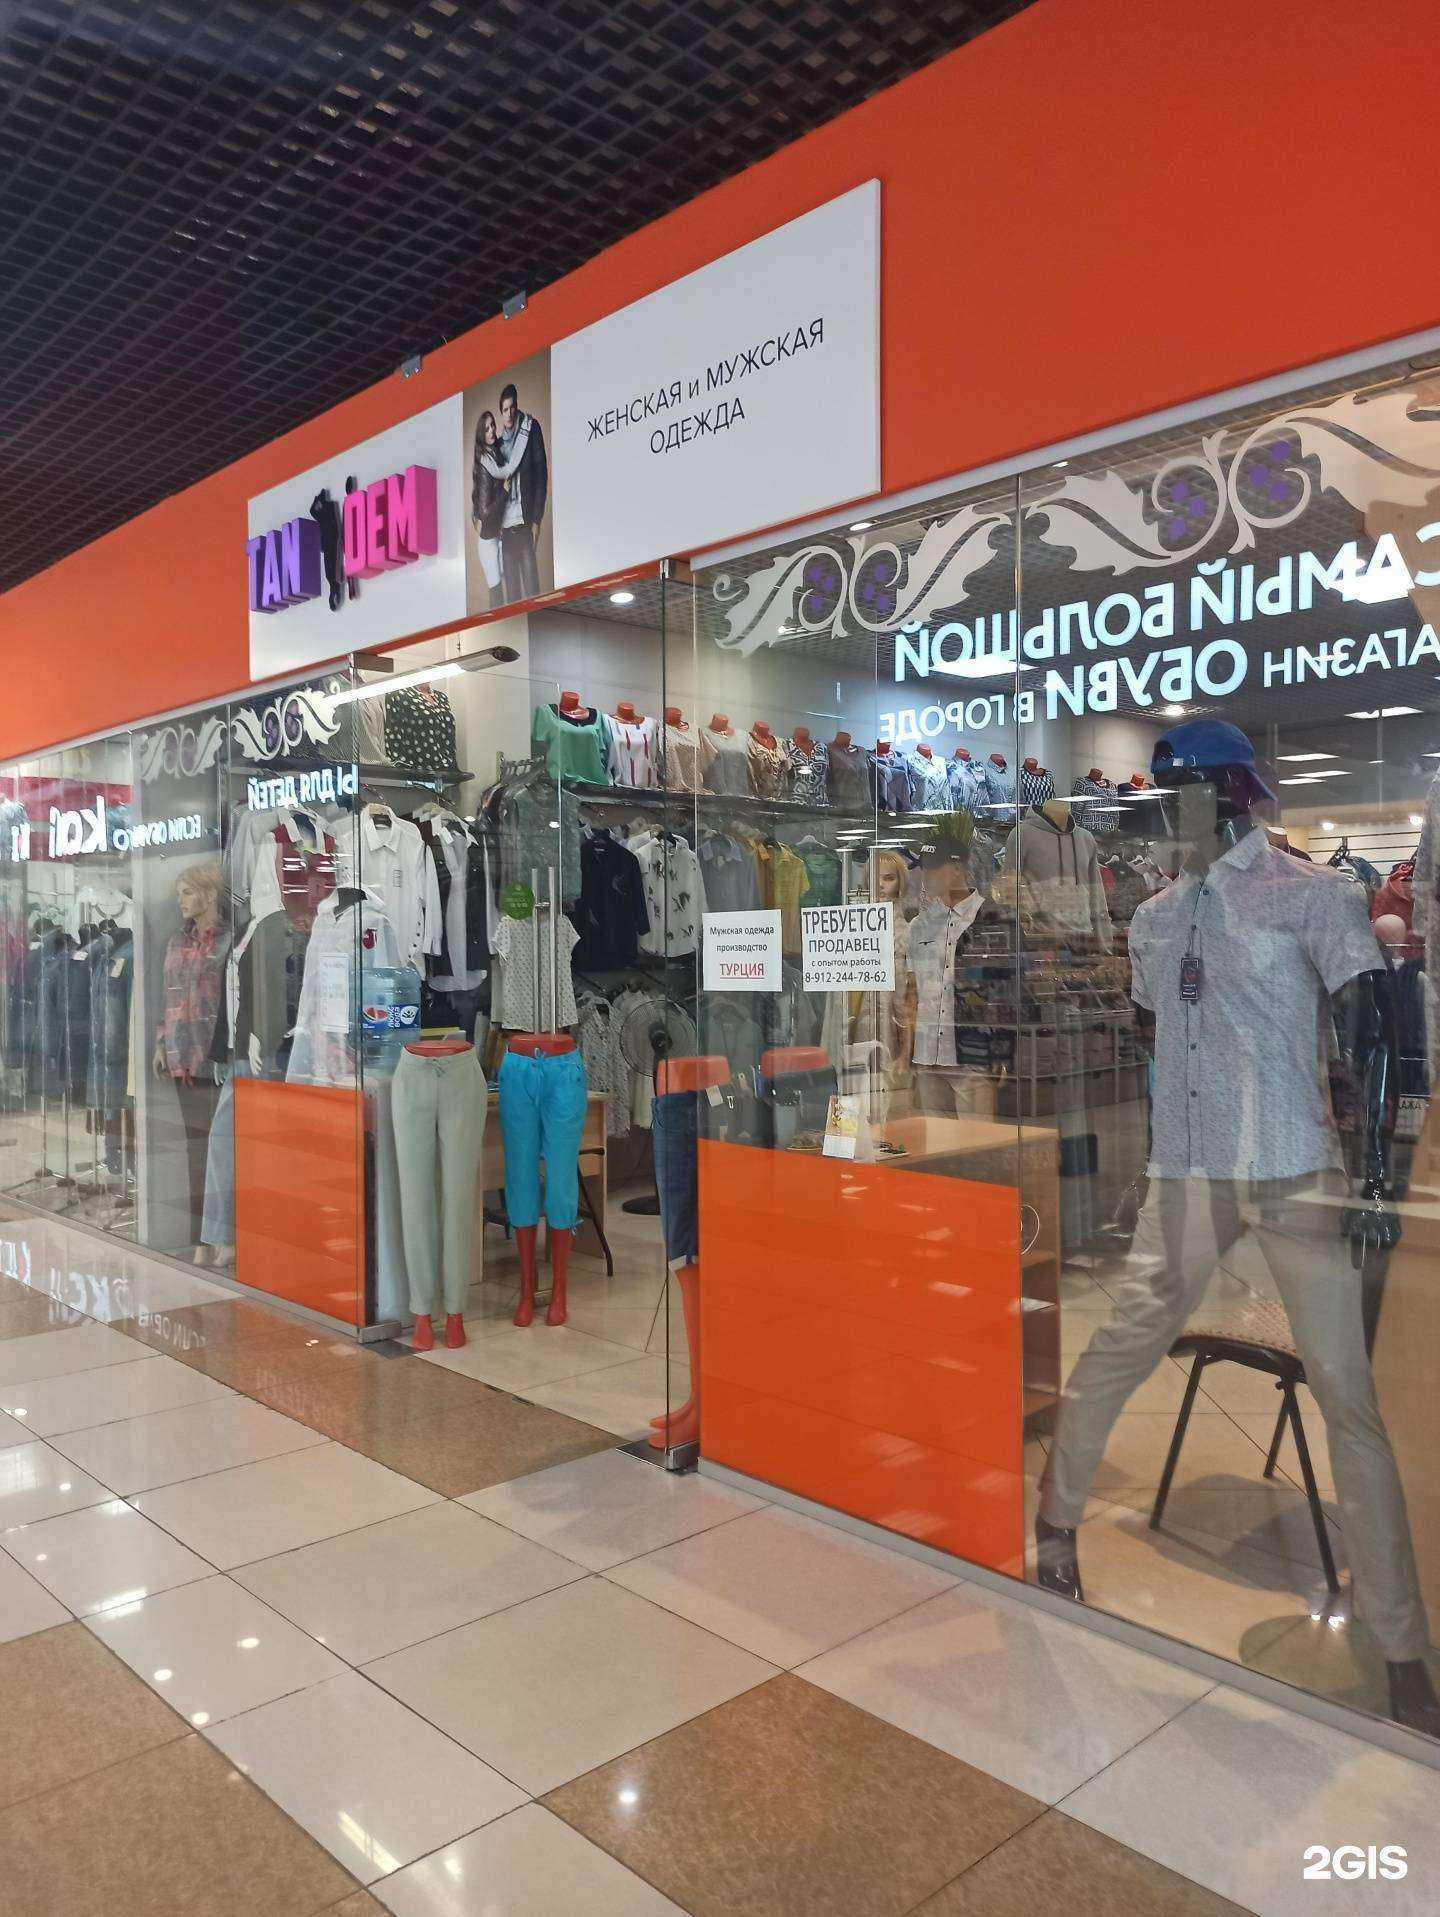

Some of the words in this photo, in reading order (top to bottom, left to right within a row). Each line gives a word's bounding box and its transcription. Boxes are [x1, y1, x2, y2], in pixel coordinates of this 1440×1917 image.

[586, 381, 682, 442] ЖЕНСКАЯ
[706, 318, 825, 388] МУЖСКАЯ
[650, 397, 746, 455] ОДЕЖДА
[803, 907, 887, 935] ТРЕБУЕТСЯ
[710, 925, 743, 937] Мужская
[744, 925, 774, 937] одежда
[716, 943, 768, 953] производство
[809, 938, 880, 954] ПРОДАВЕЦ
[719, 963, 764, 977] ТУРЦИЯ
[817, 959, 848, 969] опытом
[850, 957, 881, 969] работы
[804, 971, 887, 983] 8-912-244-78-62
